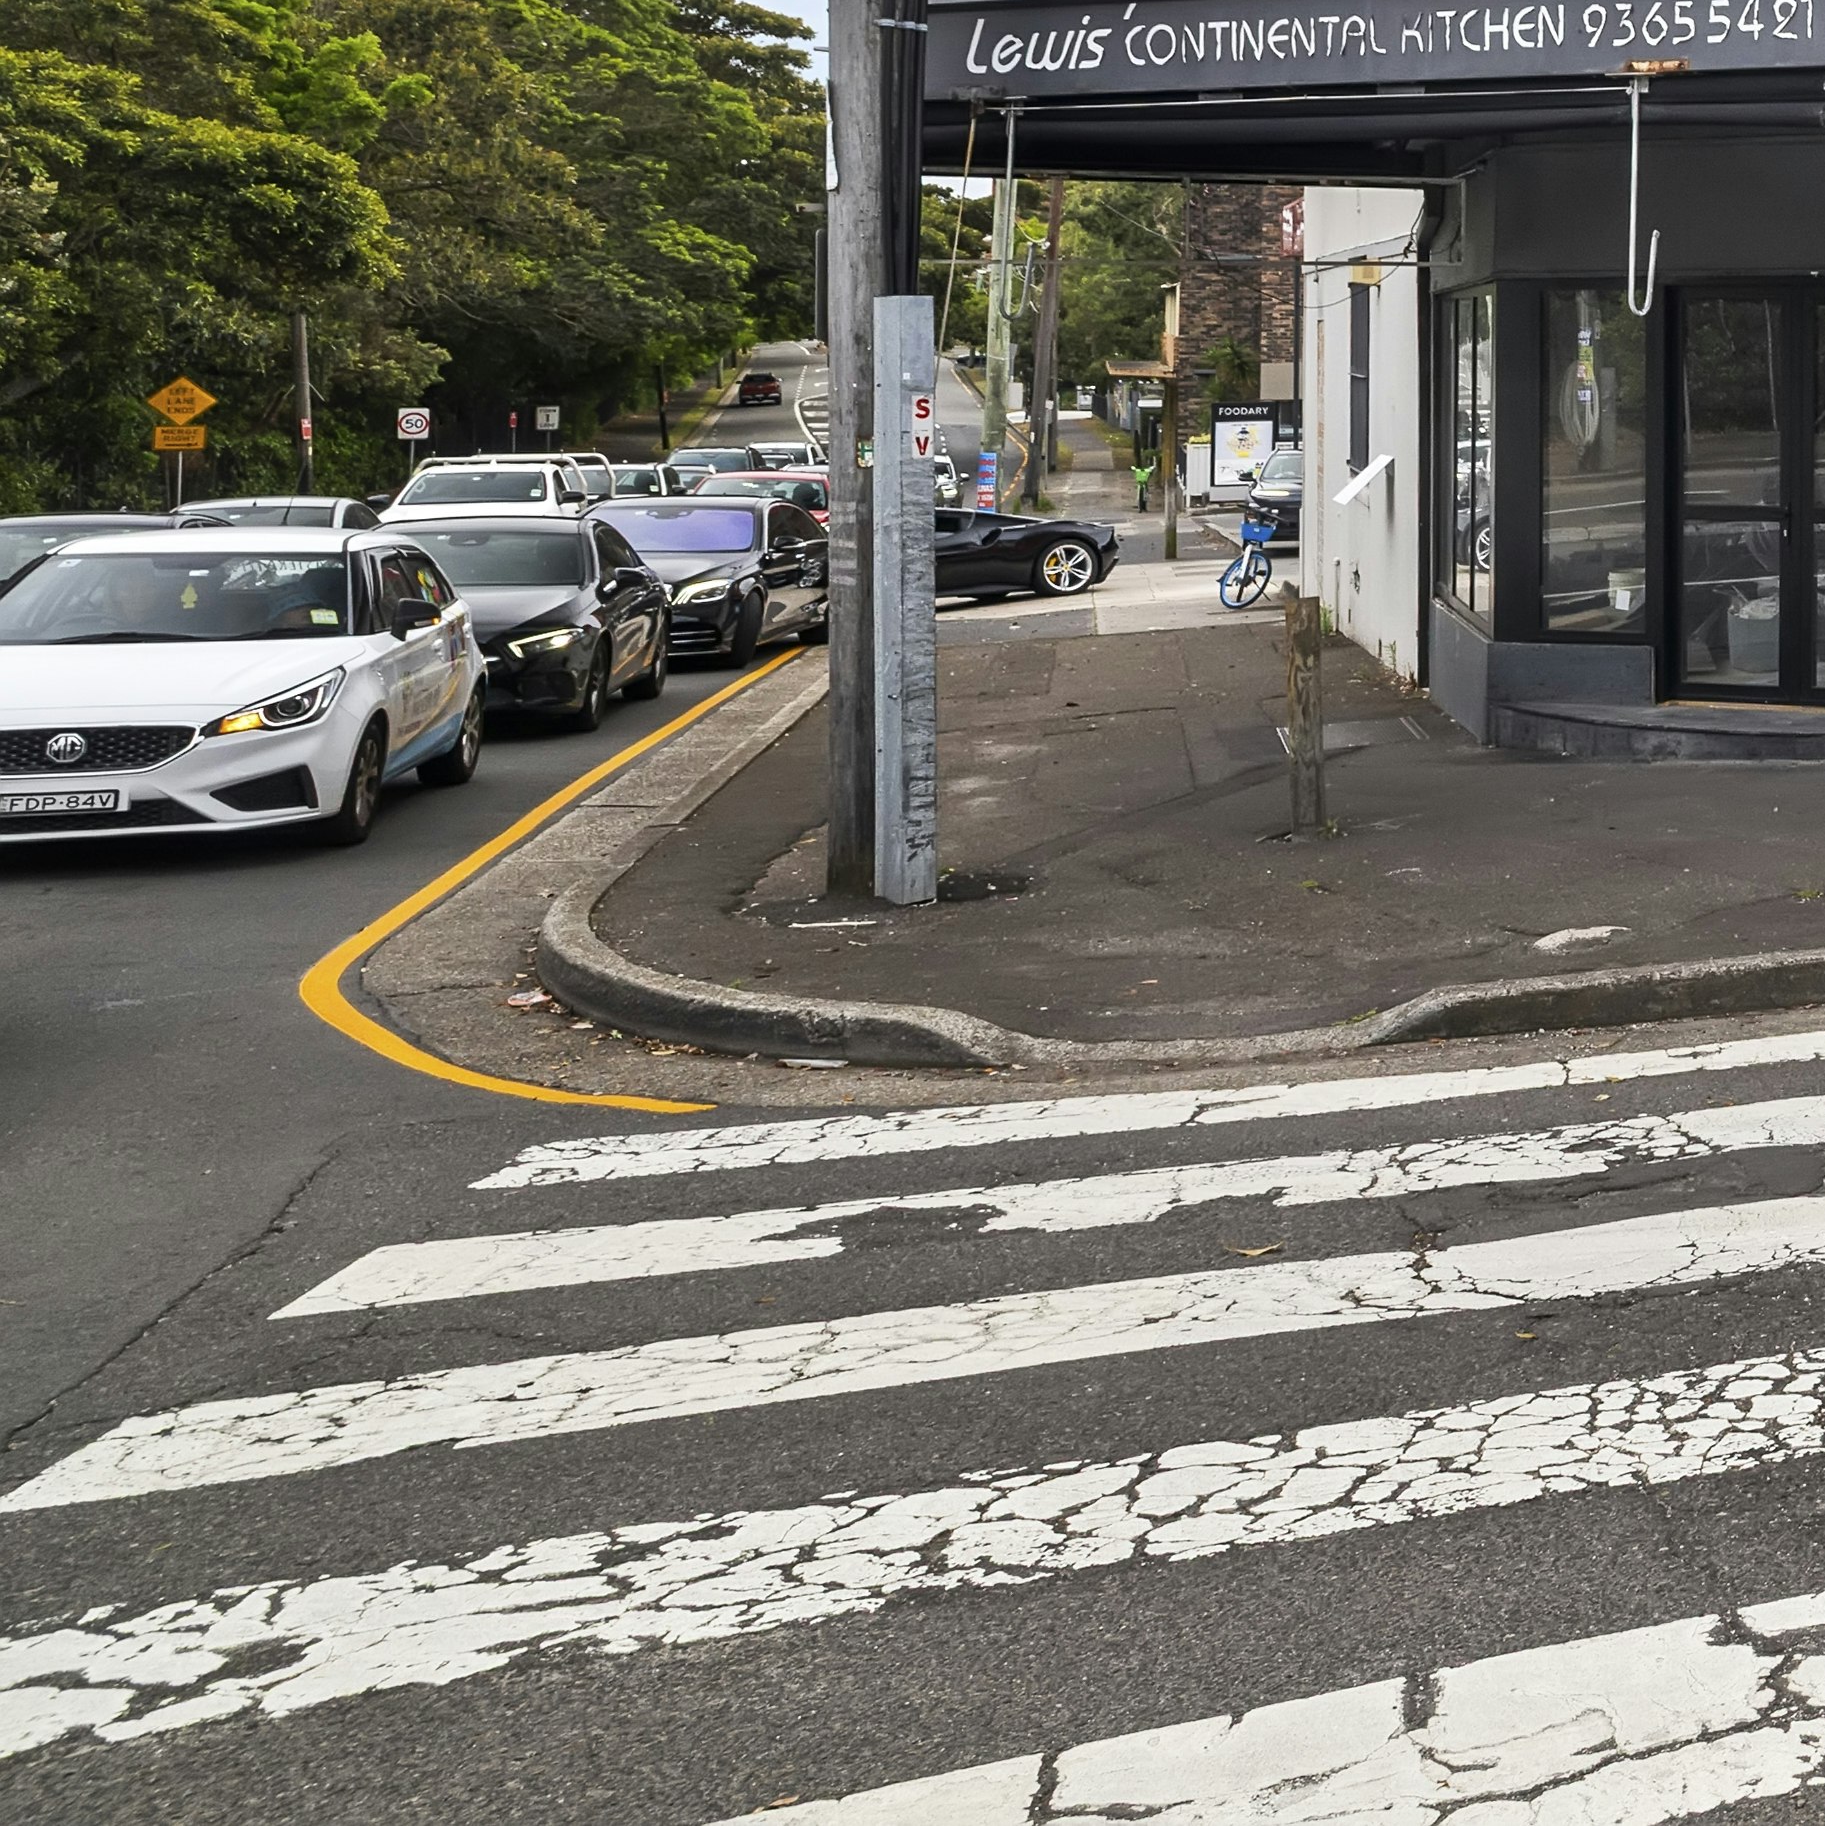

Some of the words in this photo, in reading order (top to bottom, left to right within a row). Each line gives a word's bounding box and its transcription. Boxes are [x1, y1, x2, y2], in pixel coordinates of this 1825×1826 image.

[1123, 13, 1388, 67] CONTINENTAL
[1401, 3, 1566, 55] KITCHEN
[1582, 0, 1702, 49] 9365
[167, 397, 196, 405] LANE
[167, 406, 196, 414] ENDS
[1218, 406, 1269, 416] FOODARY
[405, 418, 424, 430] 50
[50, 735, 83, 761] MG
